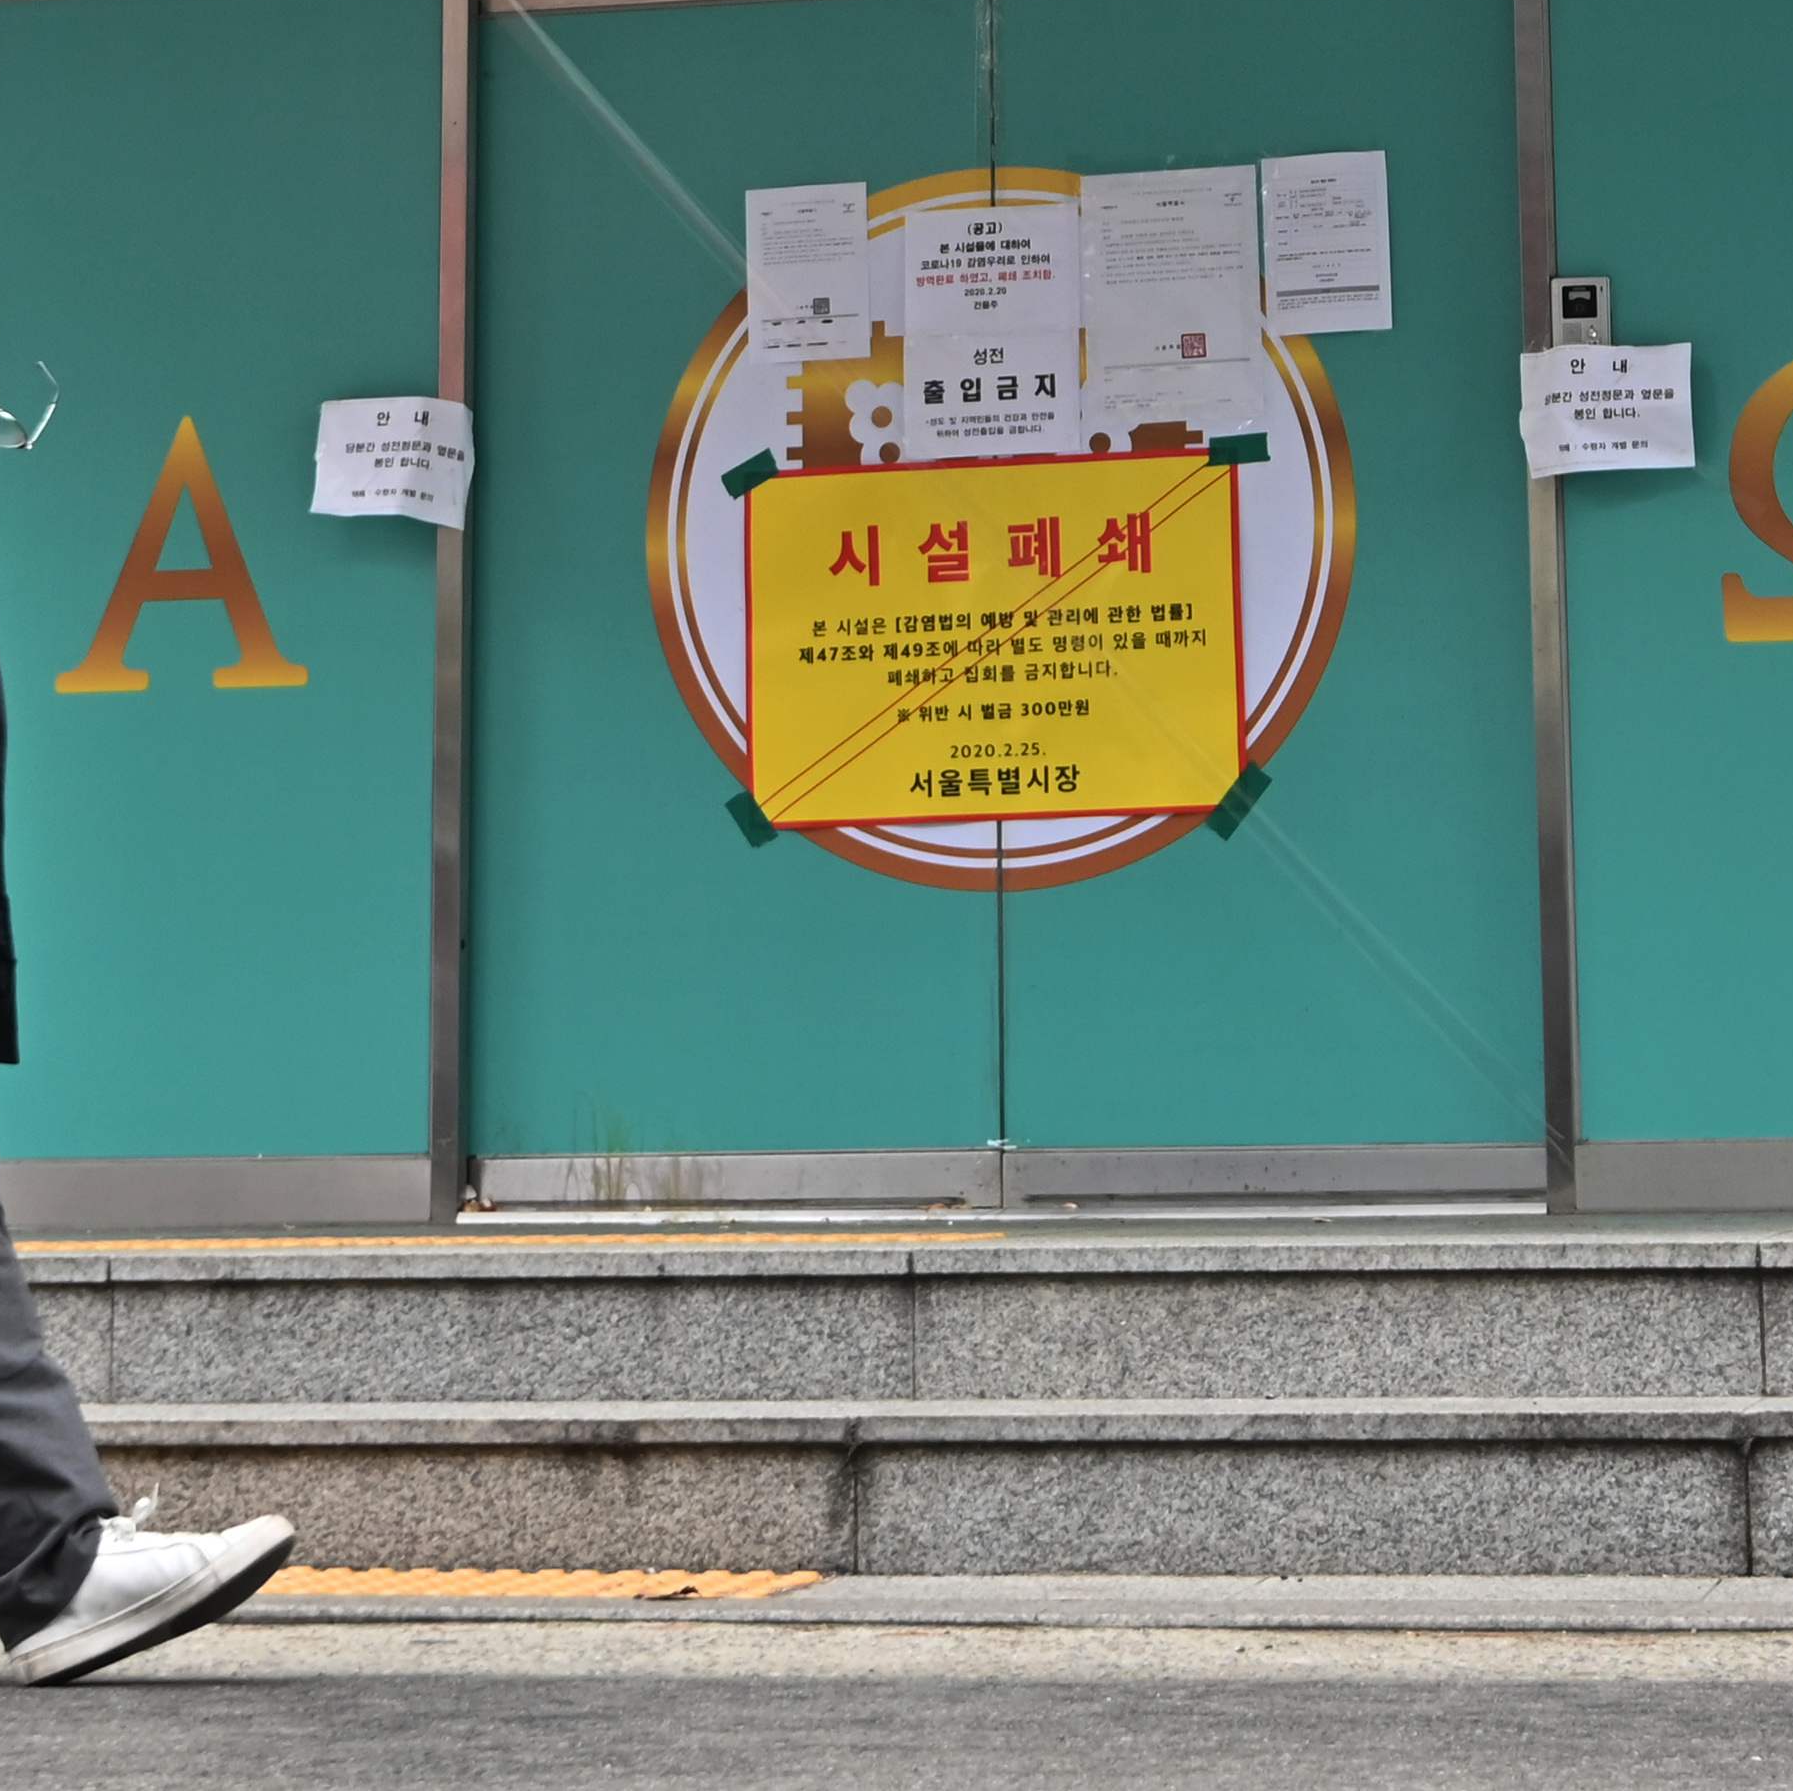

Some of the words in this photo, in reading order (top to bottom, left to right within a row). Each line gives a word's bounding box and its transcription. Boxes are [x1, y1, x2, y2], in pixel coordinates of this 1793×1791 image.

[967, 221, 1003, 236] (공고)
[939, 243, 950, 255] 본
[954, 240, 996, 253] 시설물에
[1000, 238, 1031, 251] 대하여
[920, 258, 962, 271] 코로나19
[967, 255, 1017, 269] 감염우려로
[1020, 252, 1051, 266] 인하여
[973, 300, 998, 311] 건물주
[973, 347, 1004, 366] 성전
[55, 415, 308, 694] A
[812, 619, 828, 638] 본
[836, 617, 887, 637] 시설은
[978, 606, 1015, 633] 예방
[1023, 605, 1039, 629] 및
[1048, 607, 1099, 627] 관리에
[1107, 604, 1142, 624] 관한
[1150, 602, 1193, 623] 법률]
[798, 643, 875, 665] 제47조와
[879, 637, 958, 663] 제49조에
[965, 636, 1002, 658] 따라
[1009, 633, 1047, 658] 별도
[1052, 633, 1103, 654] 명령이
[1112, 631, 1147, 651] 있을
[1155, 628, 1207, 649] 때까지
[884, 666, 958, 690] 폐쇄하고
[962, 661, 1017, 686] 집회를
[1024, 659, 1118, 682] 금지합니다.
[916, 703, 953, 725] 위반
[957, 703, 972, 722] 시
[980, 702, 1012, 721] 벌금
[1020, 698, 1090, 718] 300만원
[950, 741, 1046, 759] 2020.2.25.
[909, 763, 1081, 798] 서울특별시장
